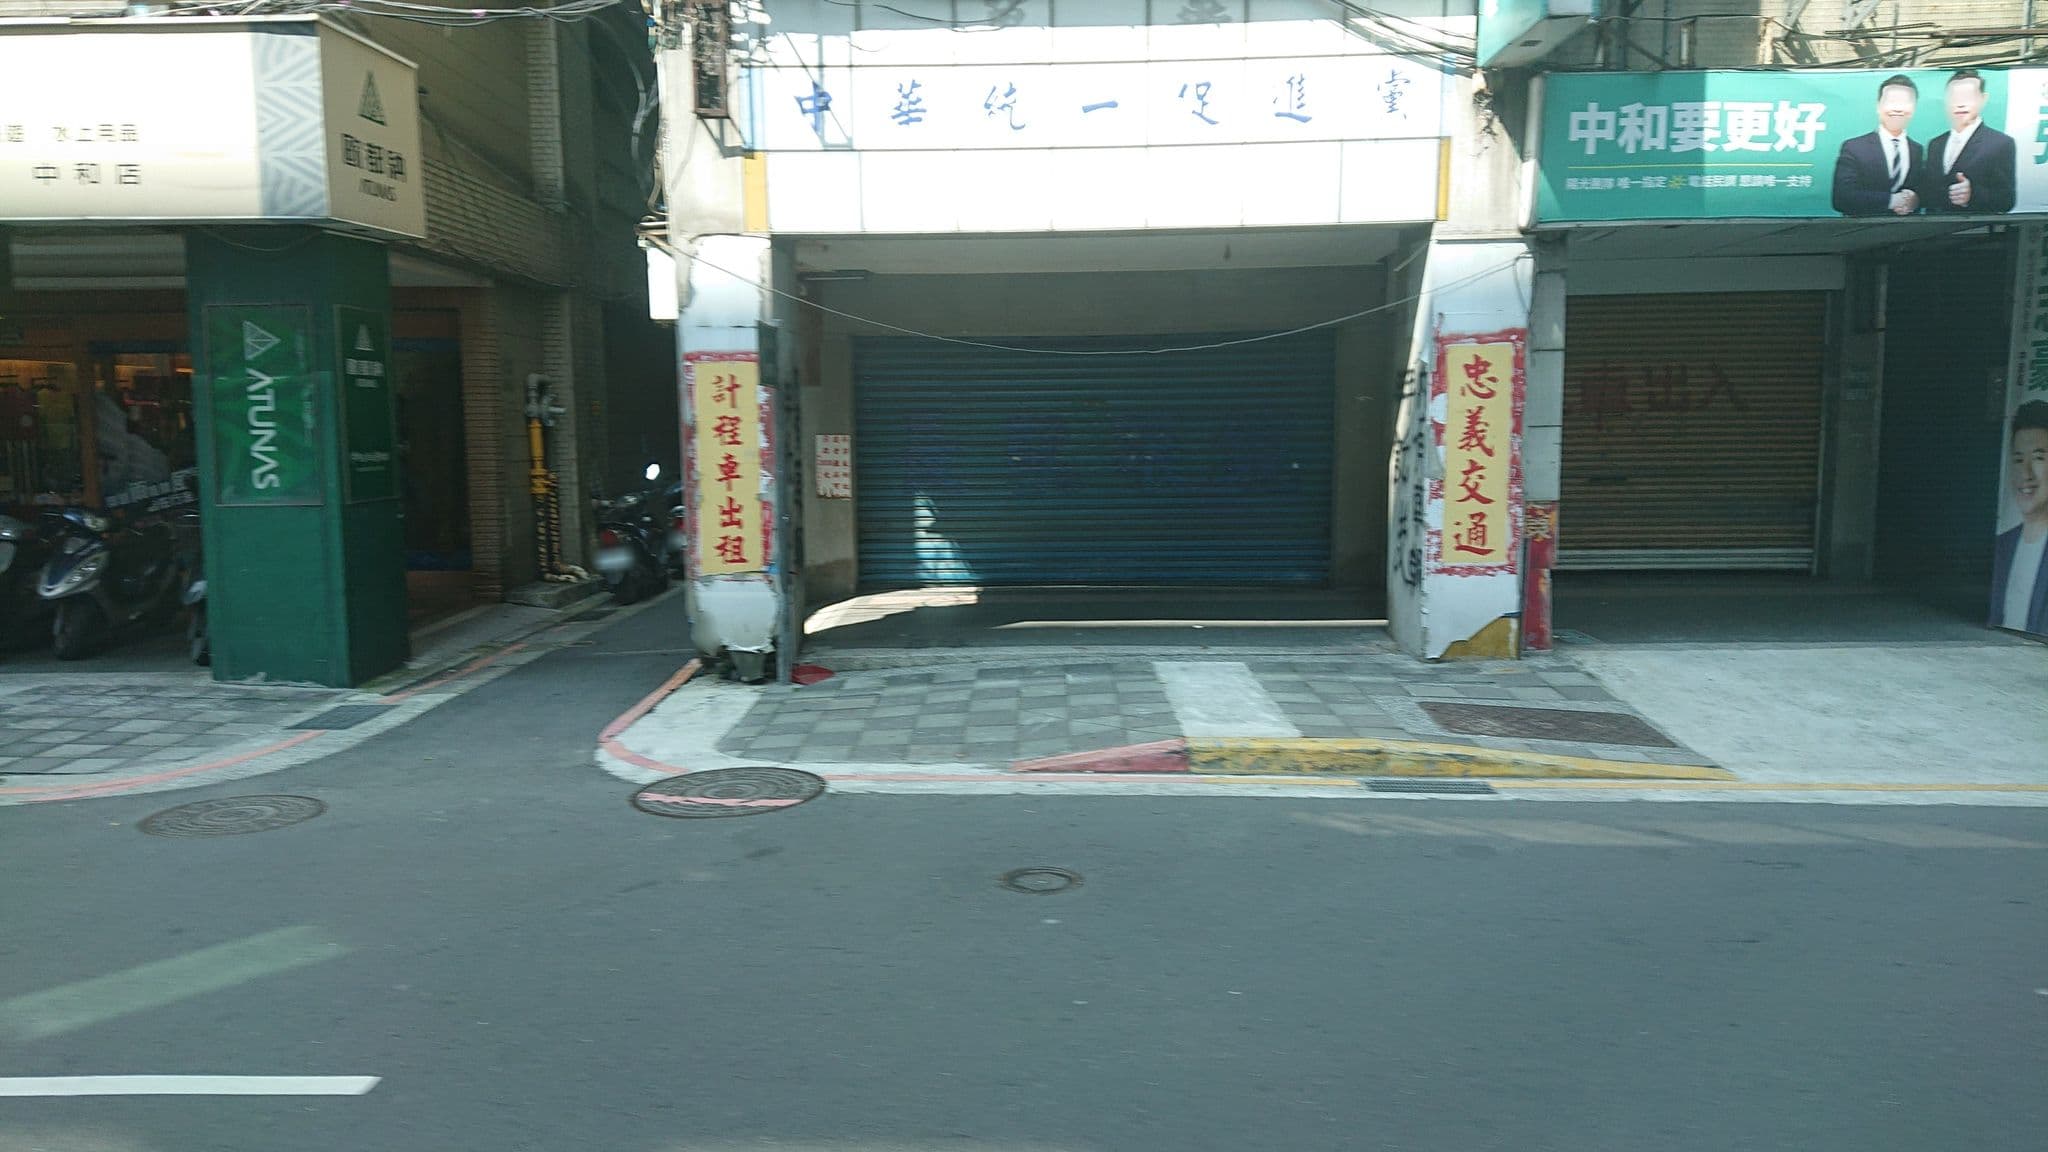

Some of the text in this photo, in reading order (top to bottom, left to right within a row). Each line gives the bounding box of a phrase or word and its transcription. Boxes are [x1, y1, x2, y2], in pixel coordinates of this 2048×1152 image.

[793, 68, 1411, 143] 中華統一促進黨
[1567, 101, 1827, 154] 中和要更好
[32, 162, 140, 185] 中和店
[711, 373, 749, 565] 計程車出租
[1454, 353, 1500, 557] 忠義交通
